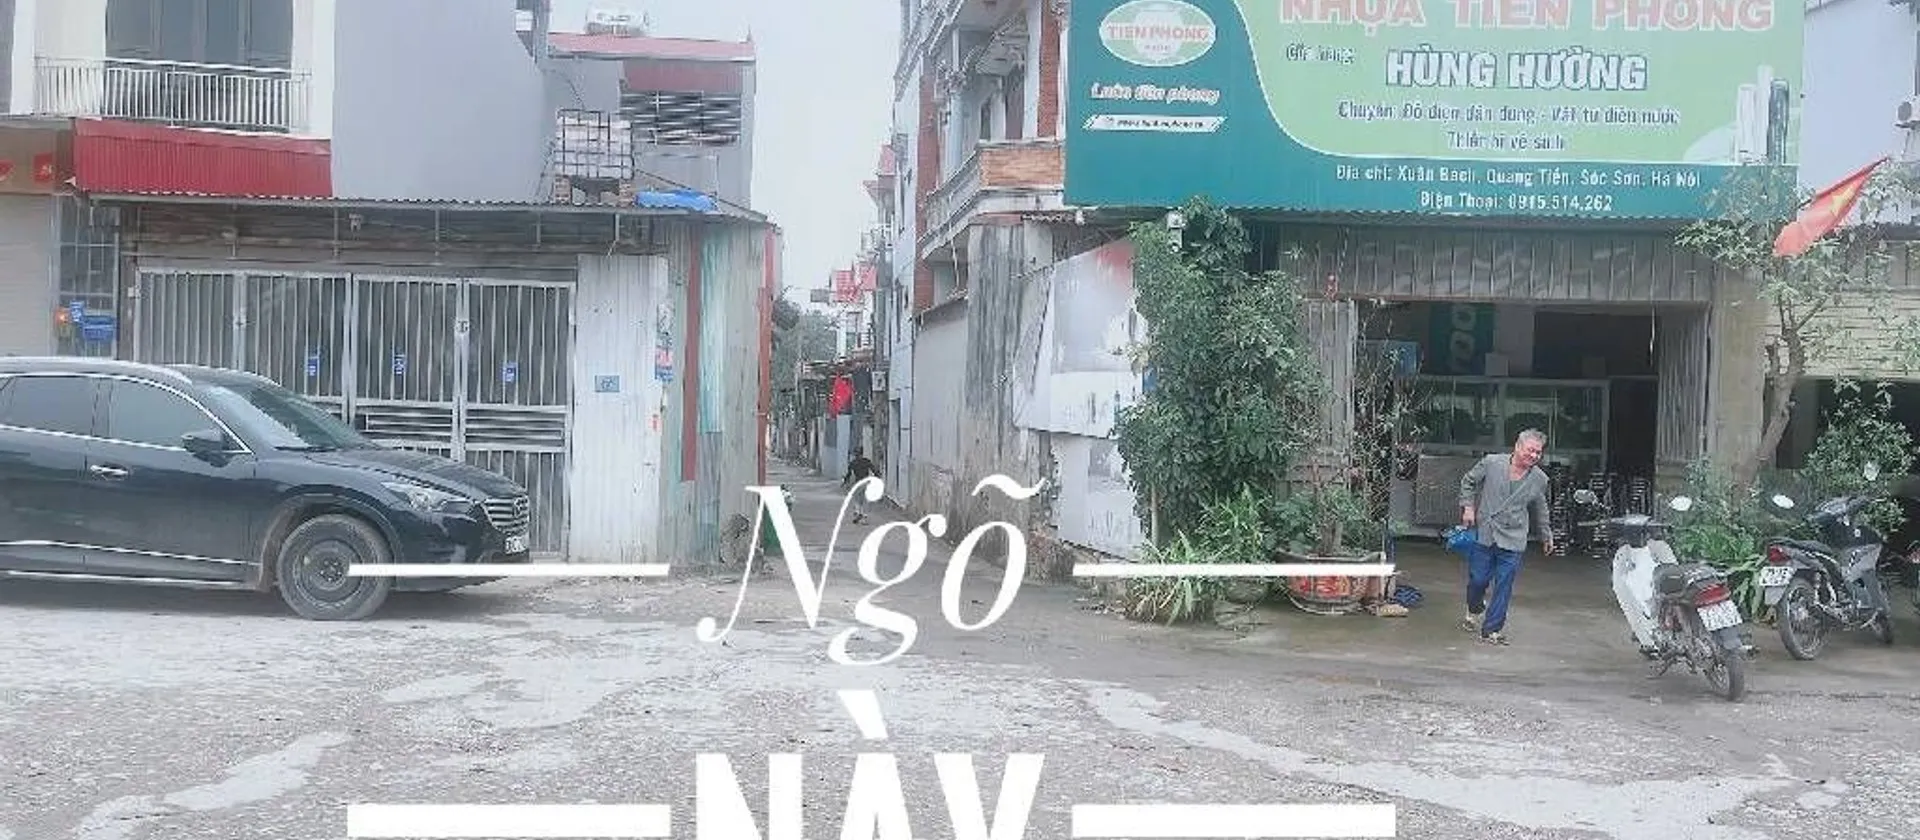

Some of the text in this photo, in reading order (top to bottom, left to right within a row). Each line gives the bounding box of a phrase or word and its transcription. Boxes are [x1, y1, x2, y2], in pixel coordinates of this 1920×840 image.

[1592, 0, 1774, 31] PHONG
[1386, 42, 1648, 92] HÙNG HƯỜNG
